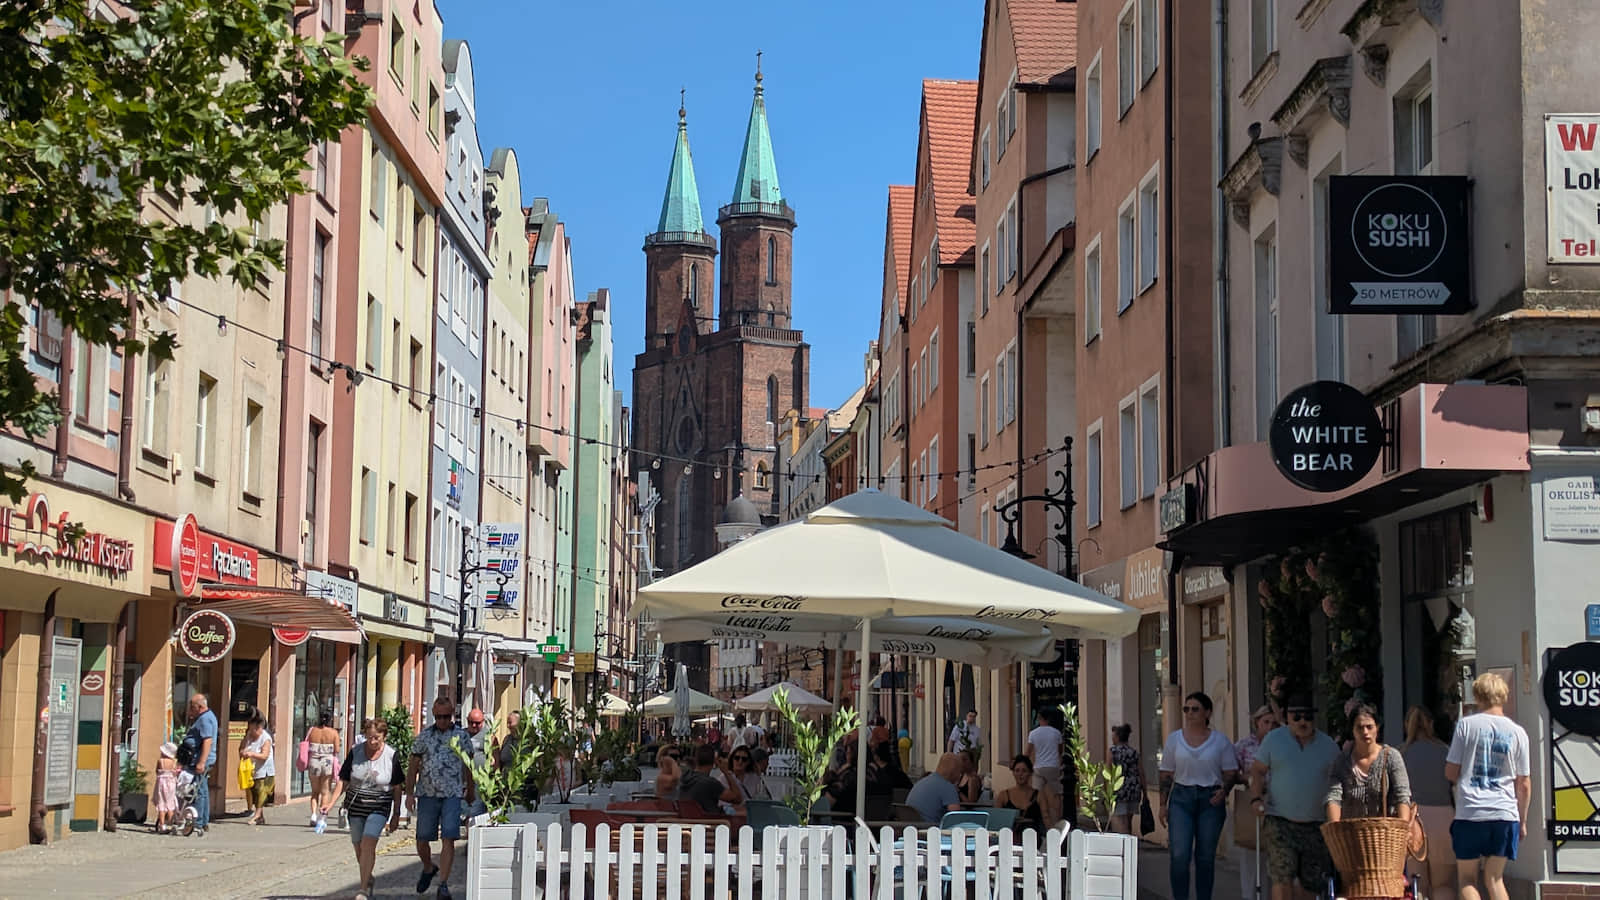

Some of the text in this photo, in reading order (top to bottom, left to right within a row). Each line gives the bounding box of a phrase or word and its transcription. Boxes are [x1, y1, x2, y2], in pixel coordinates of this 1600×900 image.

[1368, 213, 1430, 231] KOKU
[1369, 230, 1430, 247] SUSHI
[1361, 288, 1441, 300] 50 METRÓW
[1290, 397, 1321, 418] the
[1291, 426, 1369, 444] WHITE
[1293, 453, 1354, 471] BEAR
[501, 533, 519, 546] DGP
[98, 534, 134, 574] Książki
[500, 559, 518, 572] DGP
[1129, 559, 1161, 600] Jubiler
[189, 626, 225, 645] Coffee
[1034, 678, 1053, 689] KM
[1559, 688, 1600, 706] SUS
[1554, 825, 1600, 836] 50 MET
